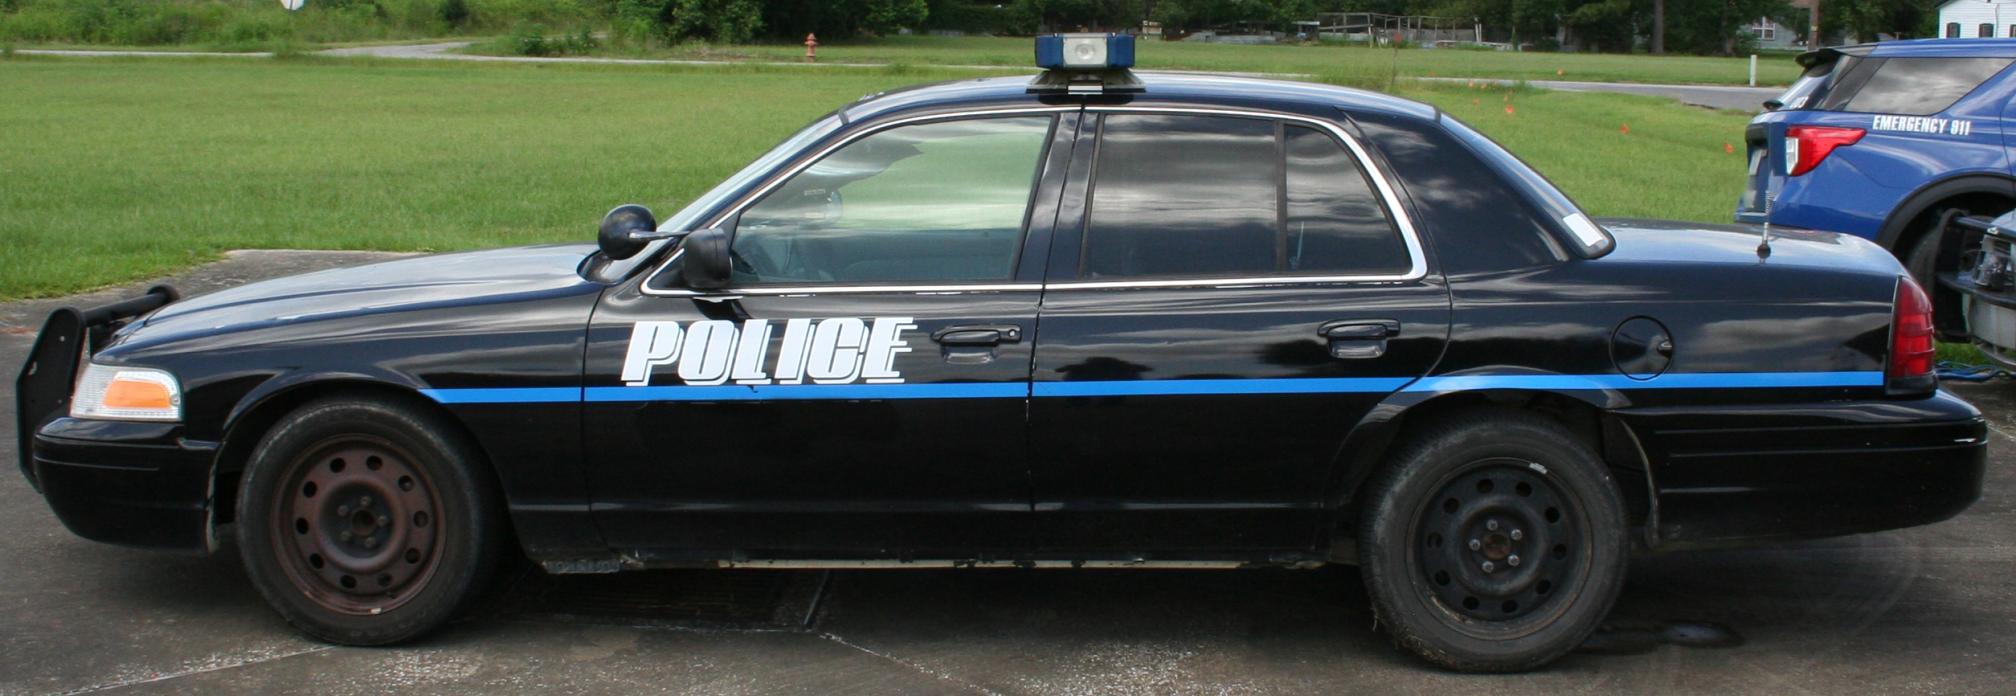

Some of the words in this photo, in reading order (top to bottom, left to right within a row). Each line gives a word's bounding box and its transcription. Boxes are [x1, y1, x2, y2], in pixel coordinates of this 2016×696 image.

[1872, 115, 1947, 134] EMERGENCY
[1950, 120, 1971, 136] 911
[621, 317, 917, 386] POLICE
